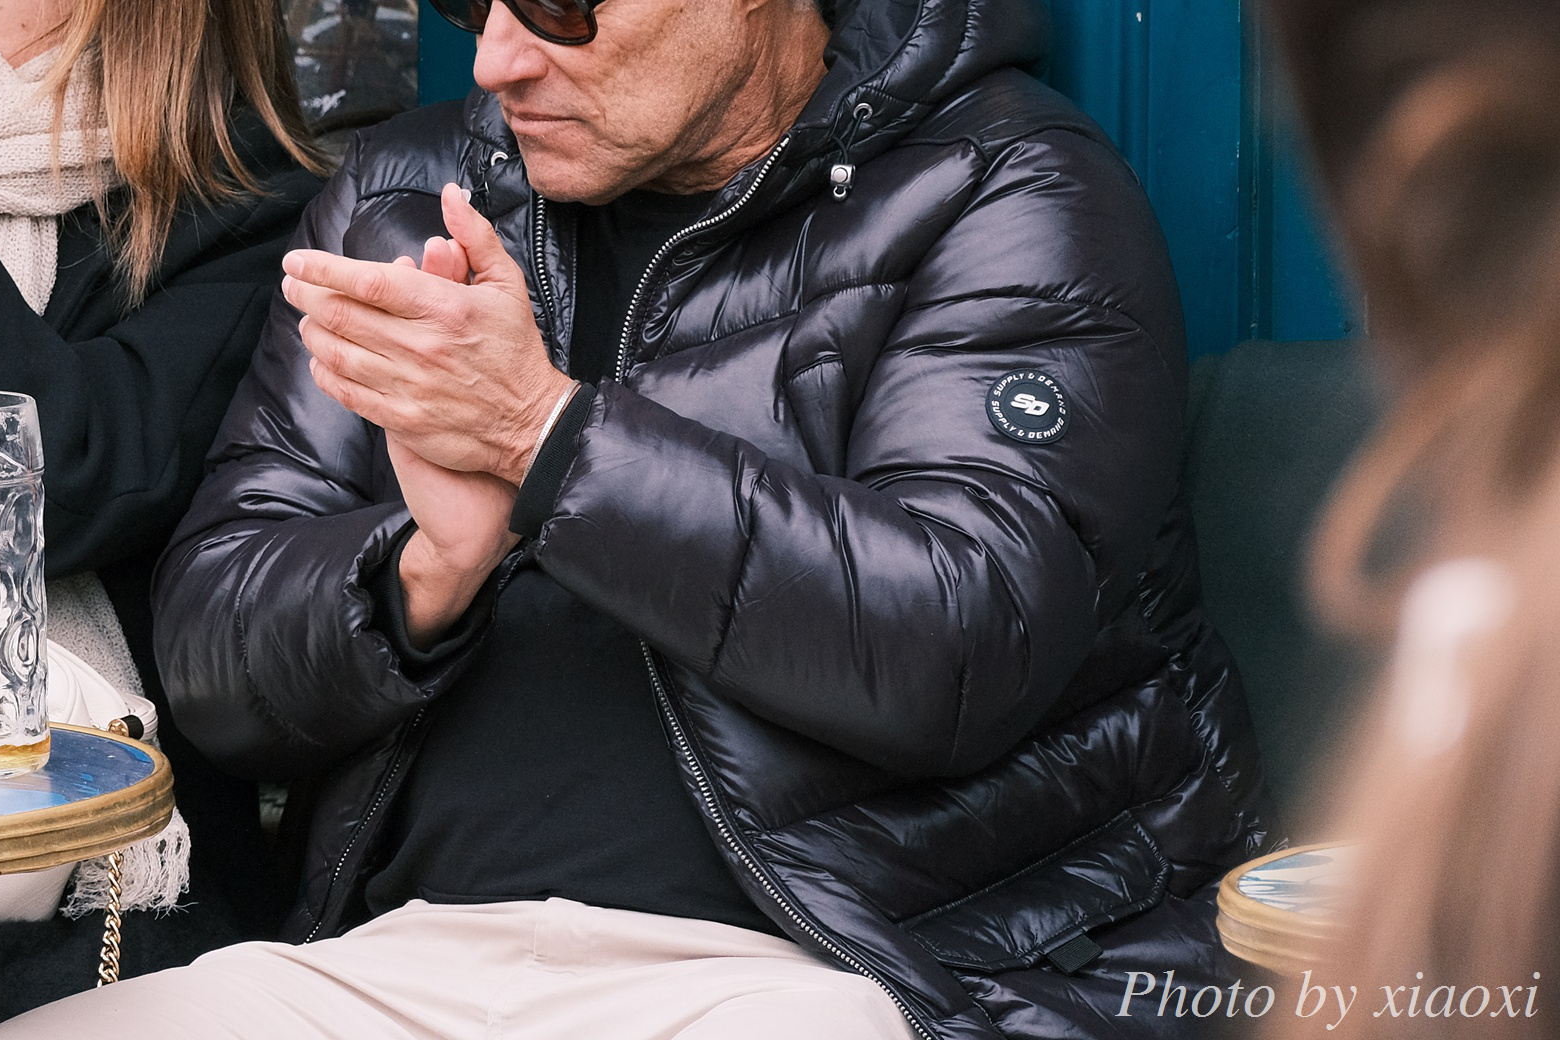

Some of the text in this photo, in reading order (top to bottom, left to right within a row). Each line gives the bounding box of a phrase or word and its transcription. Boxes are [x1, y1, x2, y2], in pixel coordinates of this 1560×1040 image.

[994, 372, 1066, 415] SUPPLY & DEMAND
[992, 401, 1017, 432] SUPPLY
[1028, 417, 1065, 439] DEMAND
